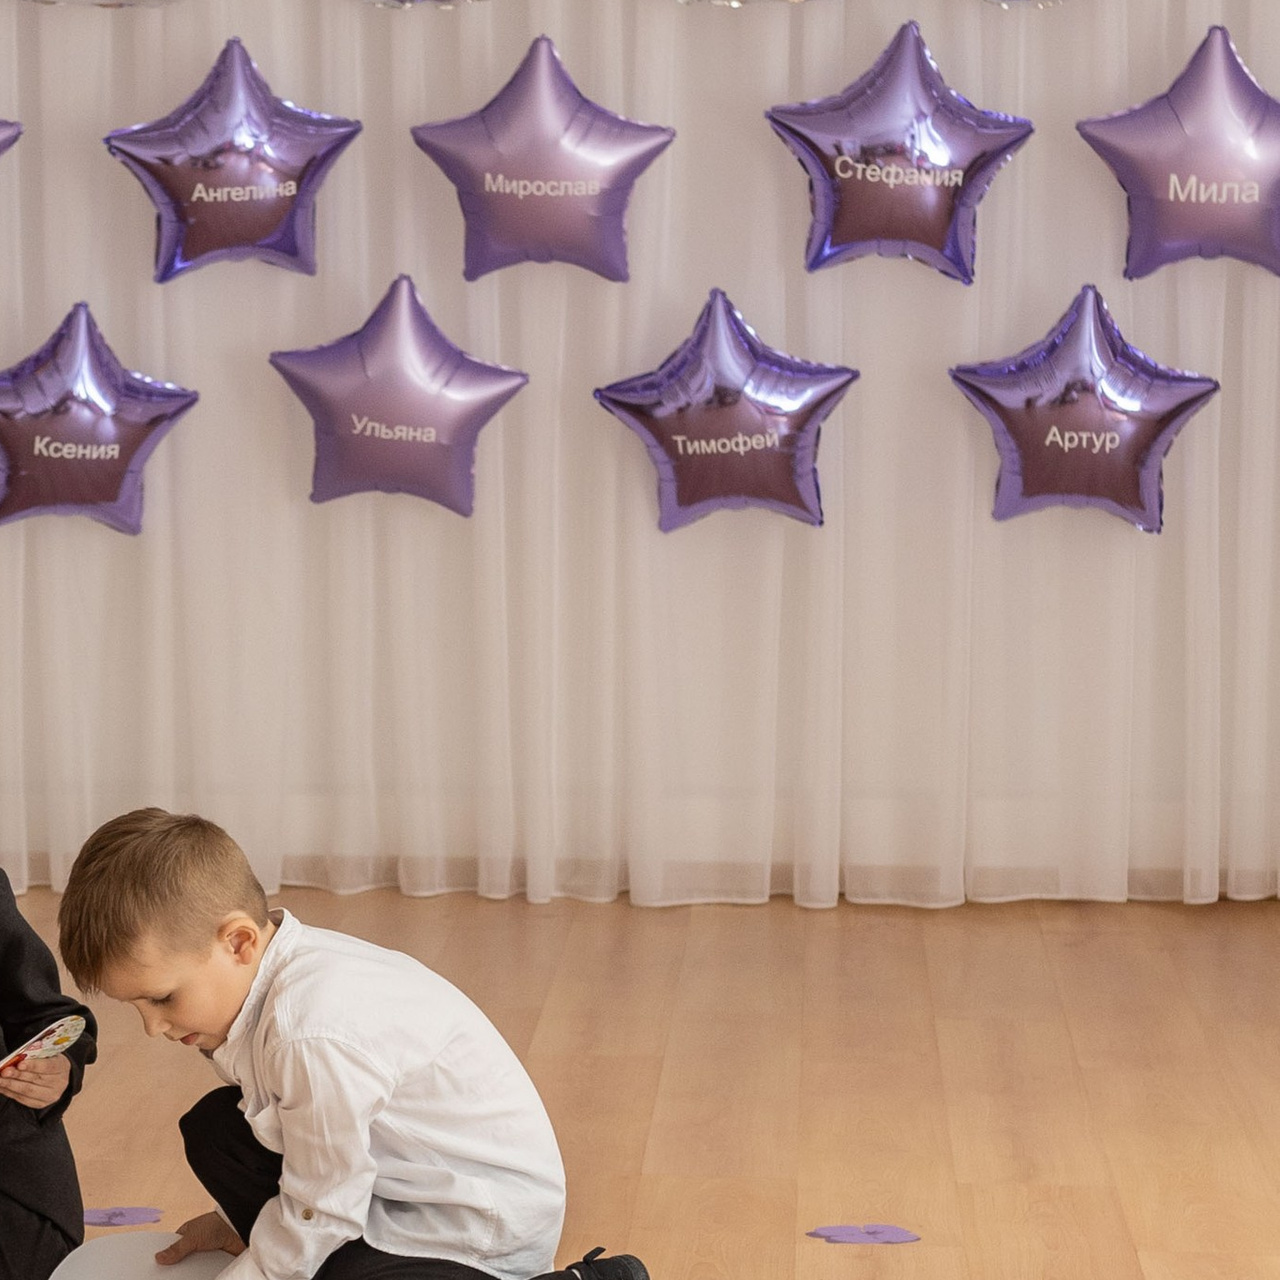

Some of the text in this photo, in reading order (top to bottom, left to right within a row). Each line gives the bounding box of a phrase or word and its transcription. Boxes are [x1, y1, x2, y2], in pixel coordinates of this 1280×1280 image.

[484, 173, 601, 200] Мирослав
[834, 156, 964, 188] Стефания
[191, 179, 297, 204] Ангелина
[1168, 173, 1260, 206] Мила
[351, 414, 437, 444] Ульяна
[672, 428, 780, 457] Тимофей
[1044, 425, 1121, 454] Артур
[32, 434, 120, 462] Ксения
